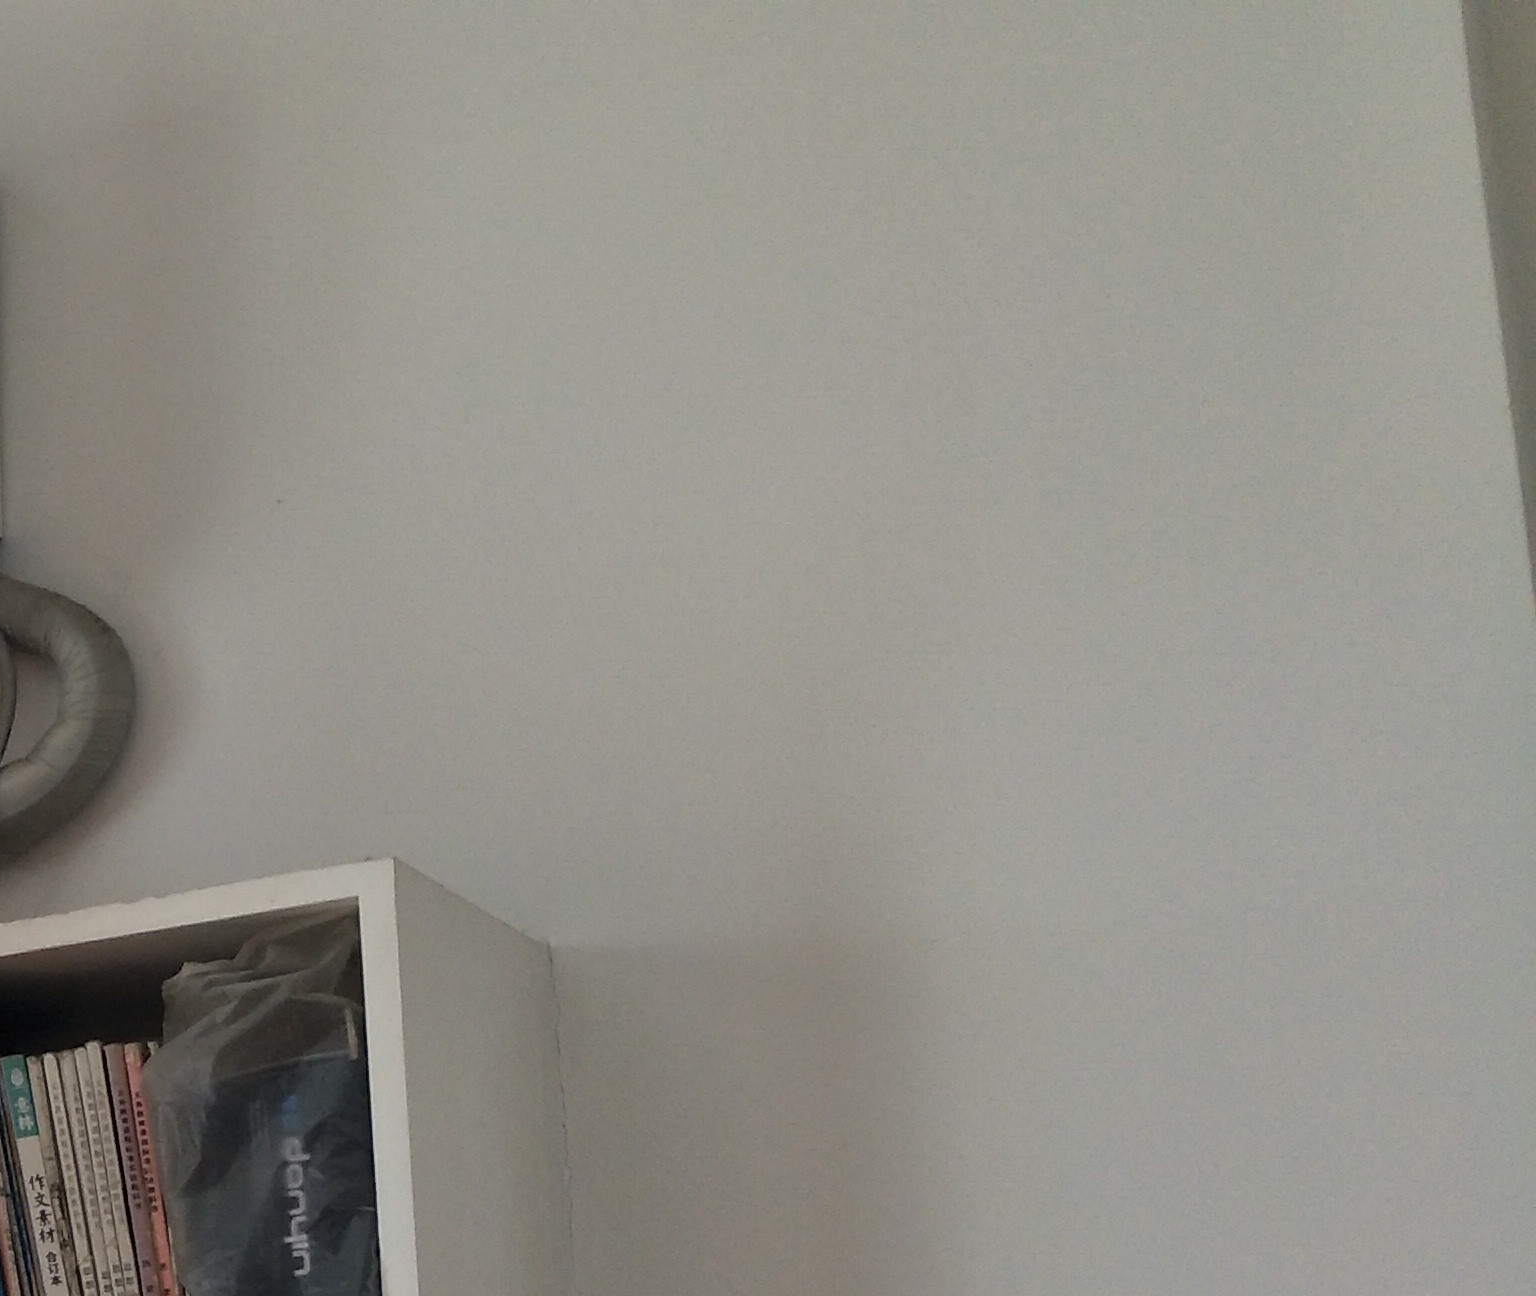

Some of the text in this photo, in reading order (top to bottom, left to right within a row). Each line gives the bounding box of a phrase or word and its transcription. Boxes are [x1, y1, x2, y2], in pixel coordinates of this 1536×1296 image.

[27, 1172, 56, 1244] 作文素材
[44, 1249, 62, 1287] 合订本
